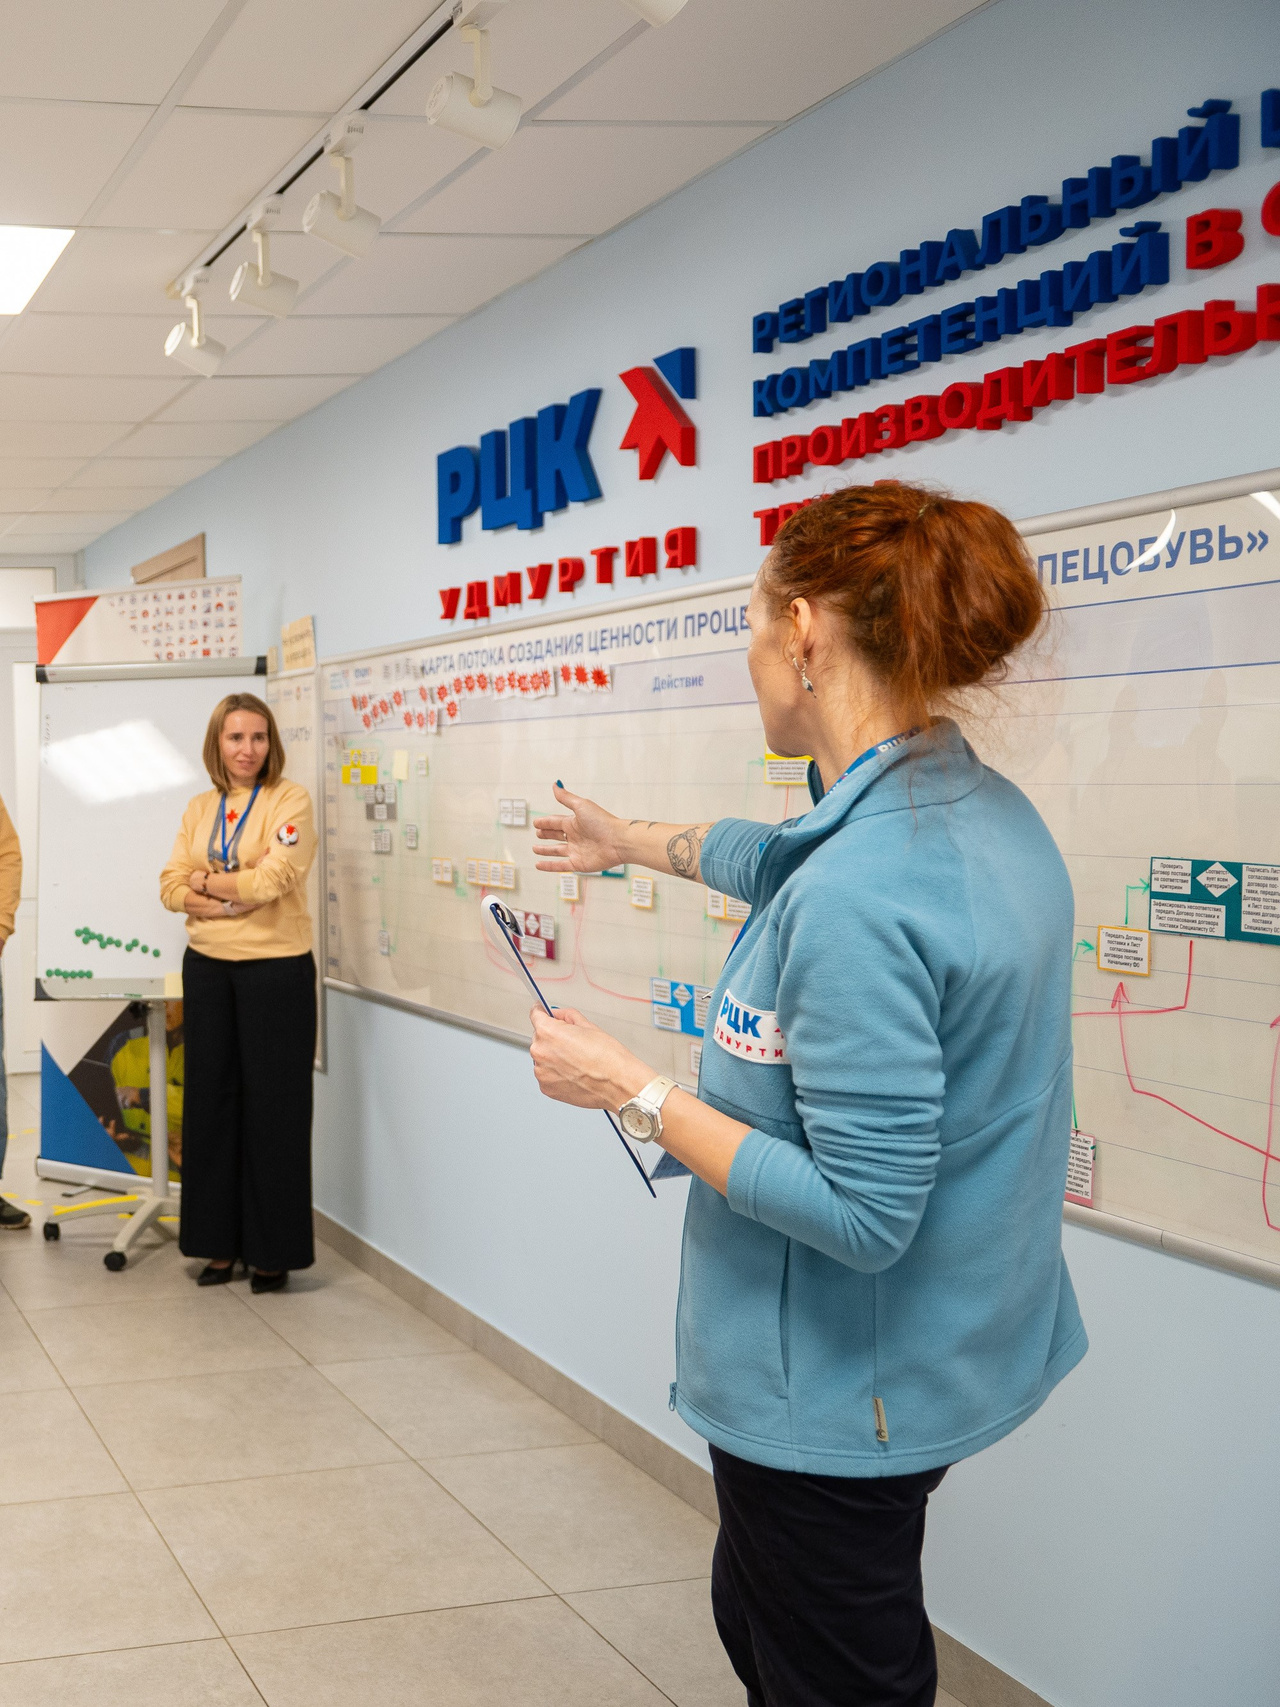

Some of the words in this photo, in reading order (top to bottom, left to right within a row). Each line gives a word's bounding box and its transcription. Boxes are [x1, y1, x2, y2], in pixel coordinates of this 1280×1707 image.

[752, 99, 1240, 353] РЕГИОНАЛЬНЫЙ
[752, 221, 1170, 418] КОМПЕТЕНЦИЙ
[1186, 208, 1245, 270] В
[437, 387, 603, 545] РЦК
[439, 526, 697, 620] УДМУРТИЯ
[1037, 524, 1269, 586] ПЕЦОБУВЬ»
[421, 654, 455, 677] КАРТА
[458, 645, 504, 671] ПОТОКА
[508, 631, 583, 663] СОЗДАНИЯ
[588, 619, 677, 655] ЦЕННОСТИ
[683, 605, 750, 638] ПРОЦЕ
[653, 674, 704, 692] Действие
[715, 1025, 783, 1058] УДМУРТИ
[720, 995, 762, 1039] РЦК
